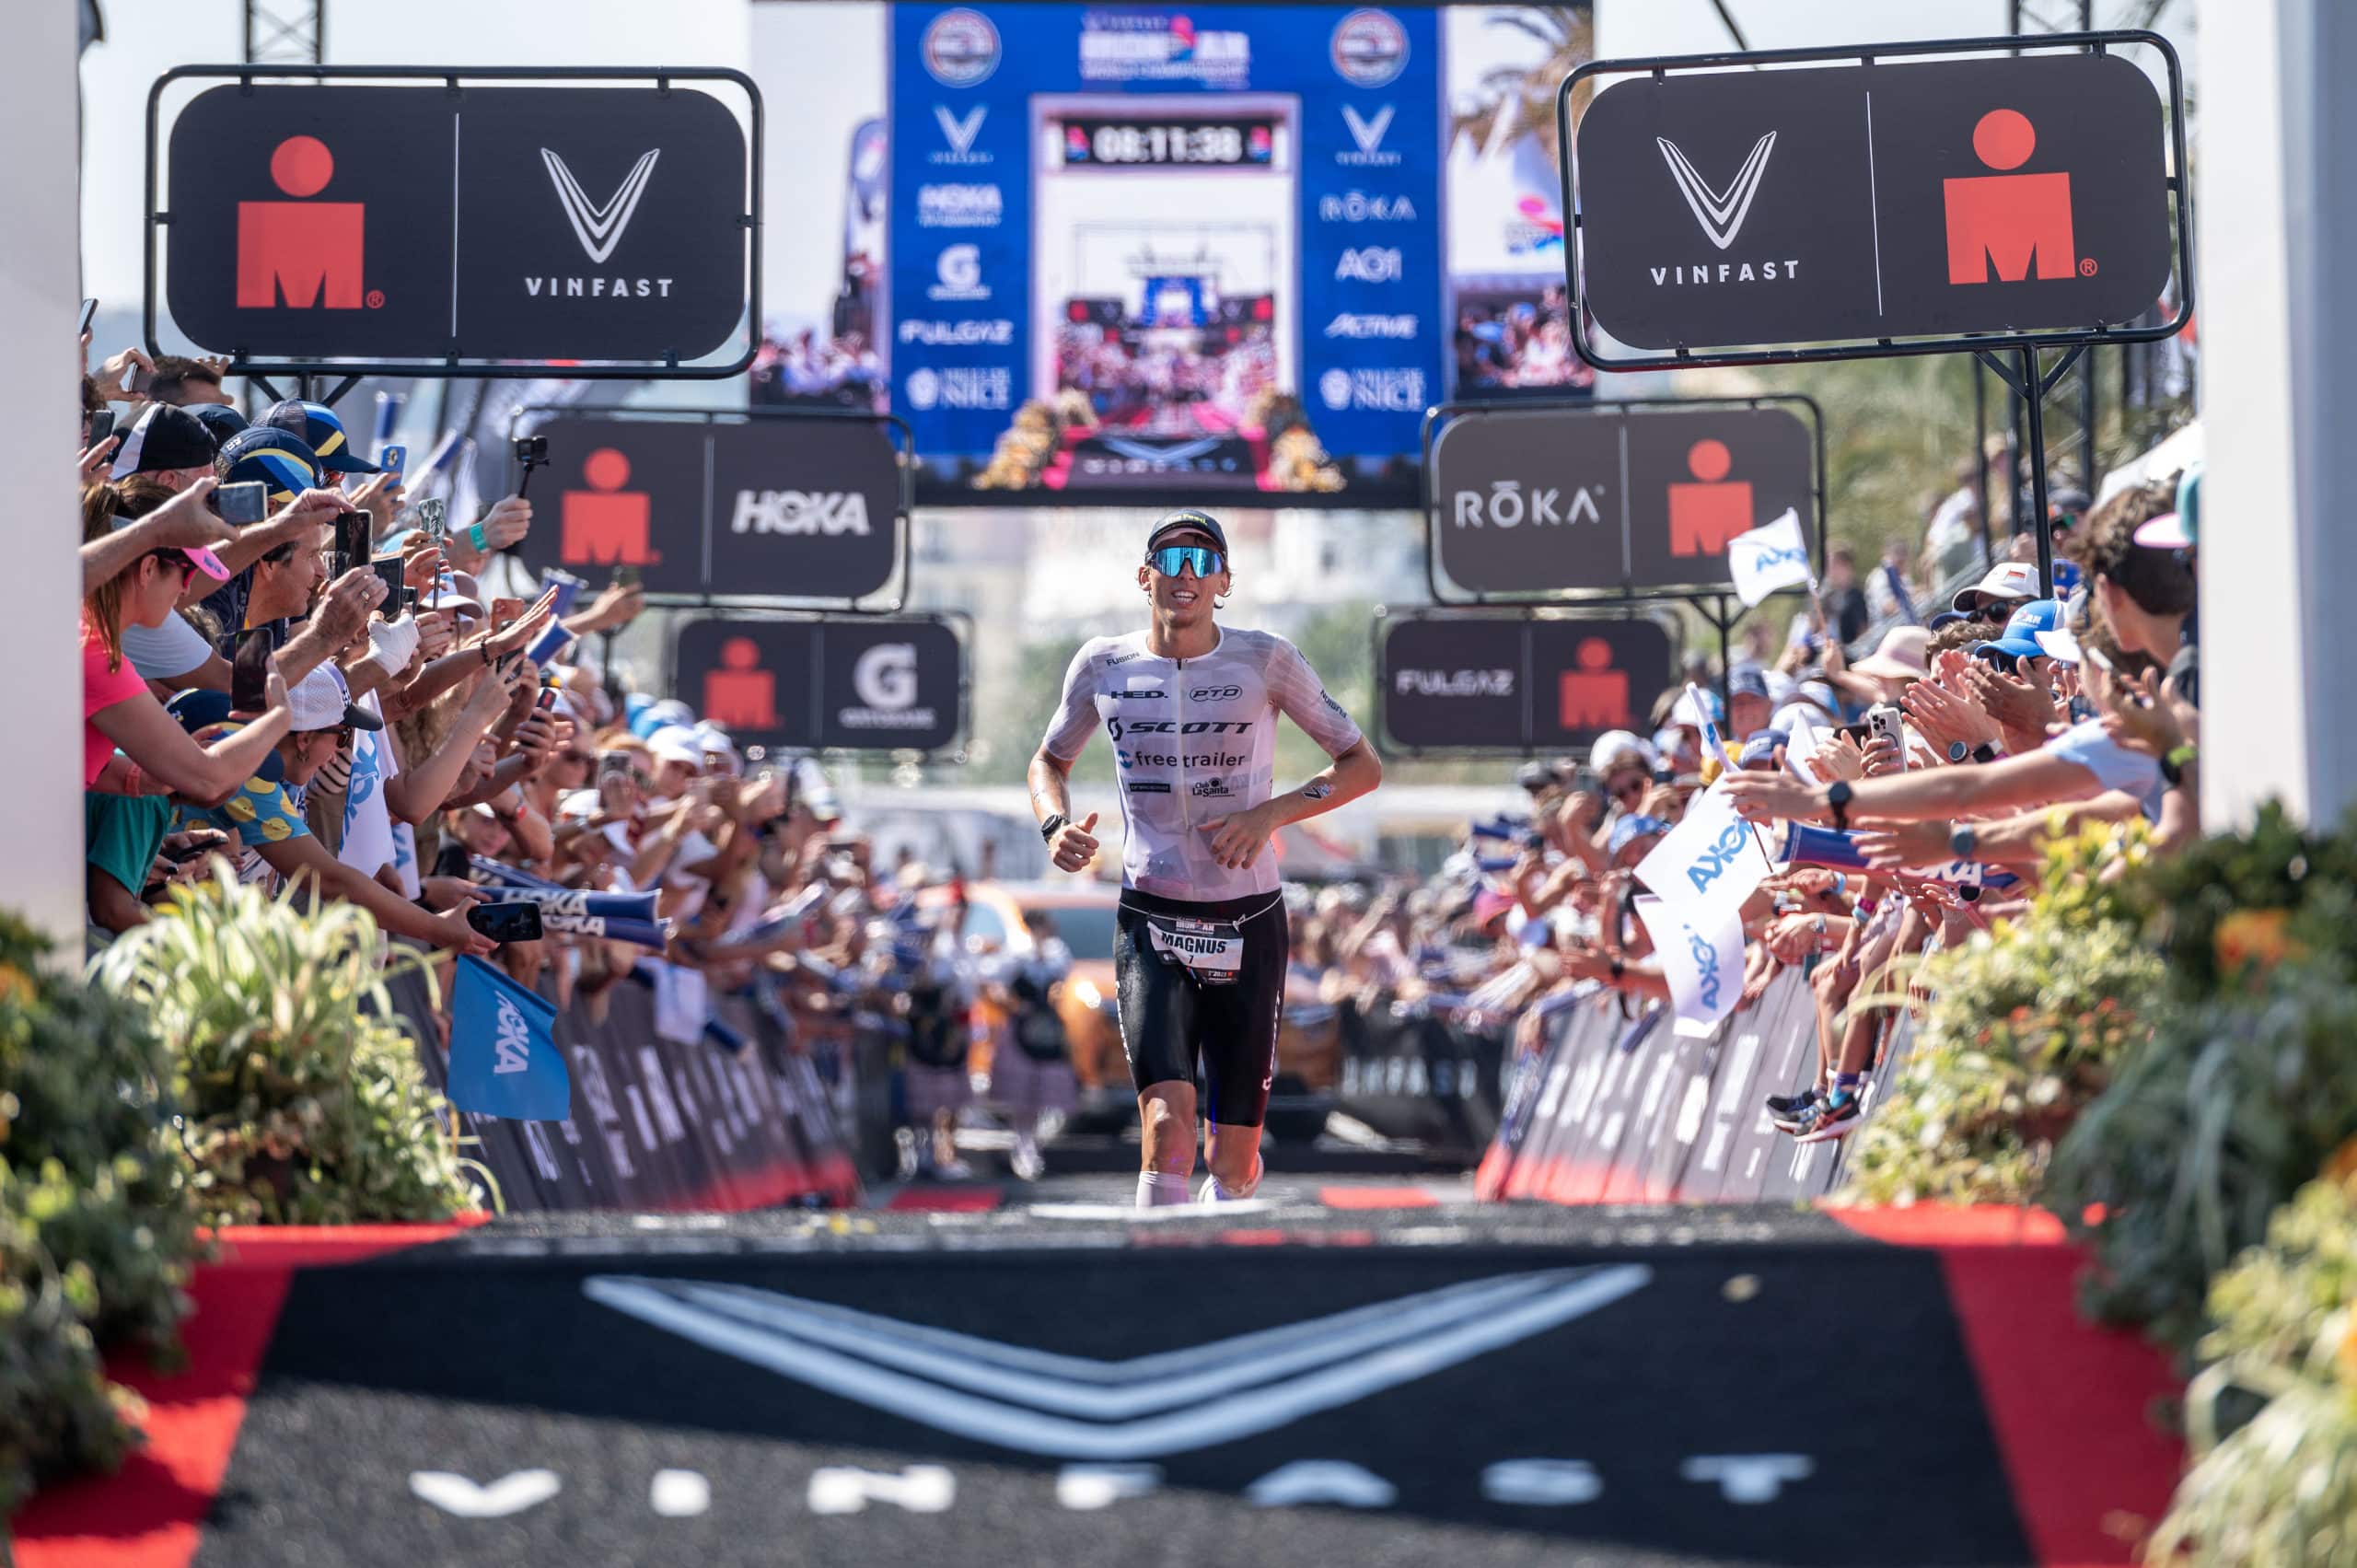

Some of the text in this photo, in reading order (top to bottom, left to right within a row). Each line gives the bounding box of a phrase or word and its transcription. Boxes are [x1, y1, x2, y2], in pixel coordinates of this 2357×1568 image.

[1651, 260, 1799, 285] VINFAST
[526, 277, 673, 297] VINFAST
[732, 491, 870, 535] HOKA
[1107, 651, 1141, 667] FUSION
[1192, 688, 1239, 699] PTO
[1396, 669, 1515, 697] FULGAZ
[1127, 722, 1253, 735] SCOTT
[541, 914, 606, 937] OKA
[1161, 932, 1227, 954] MAGNUS
[1188, 955, 1194, 964] 7
